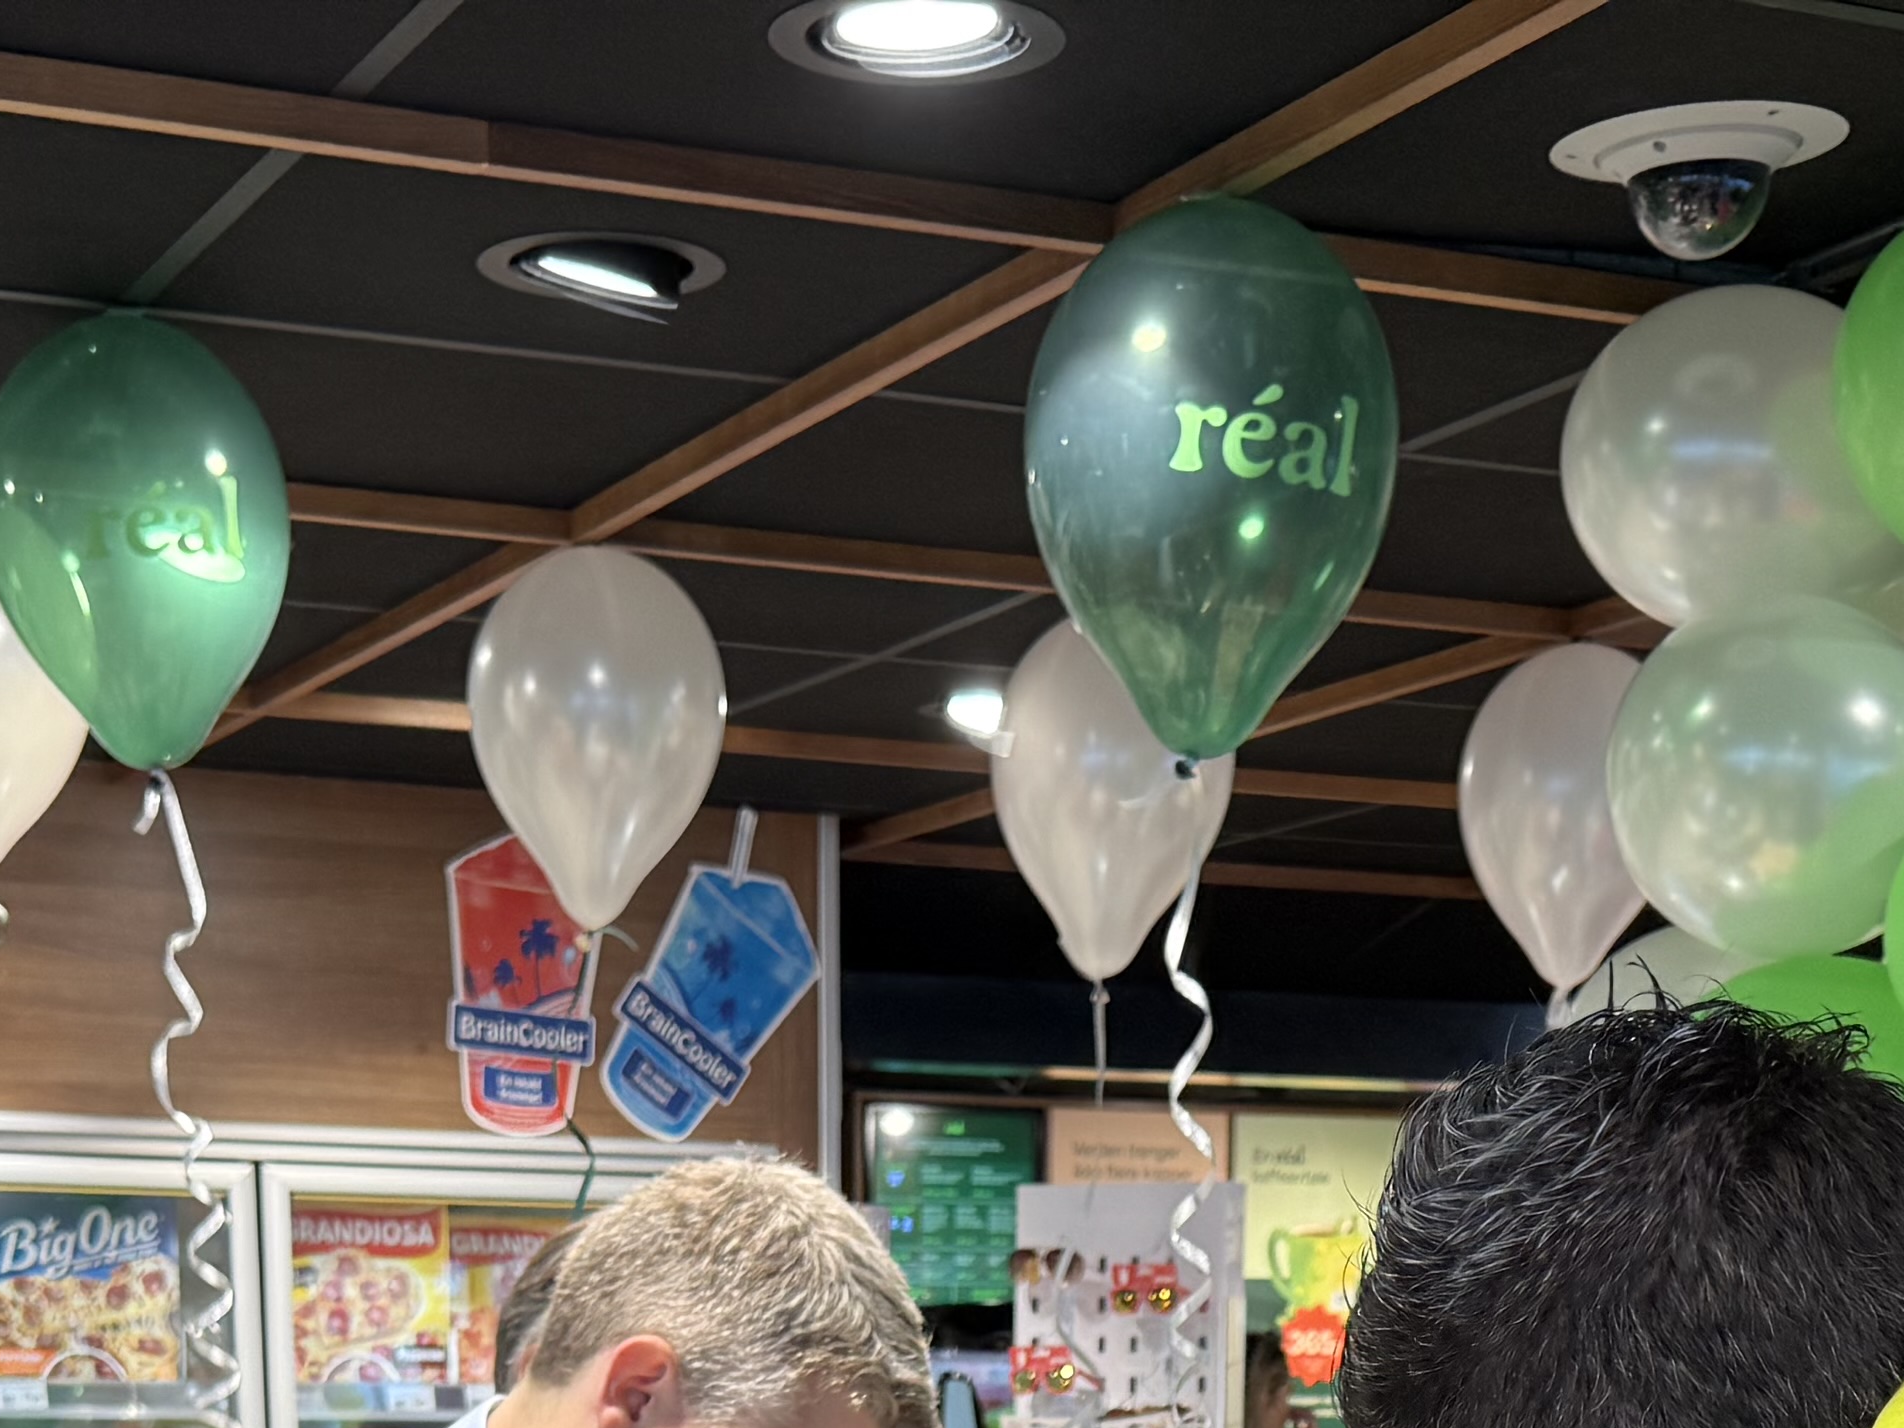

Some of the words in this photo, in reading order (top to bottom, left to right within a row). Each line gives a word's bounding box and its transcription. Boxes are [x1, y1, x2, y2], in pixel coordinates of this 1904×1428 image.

[1169, 383, 1358, 497] réal
[460, 1015, 590, 1053] BrainCooler
[628, 990, 738, 1089] BrainCooler
